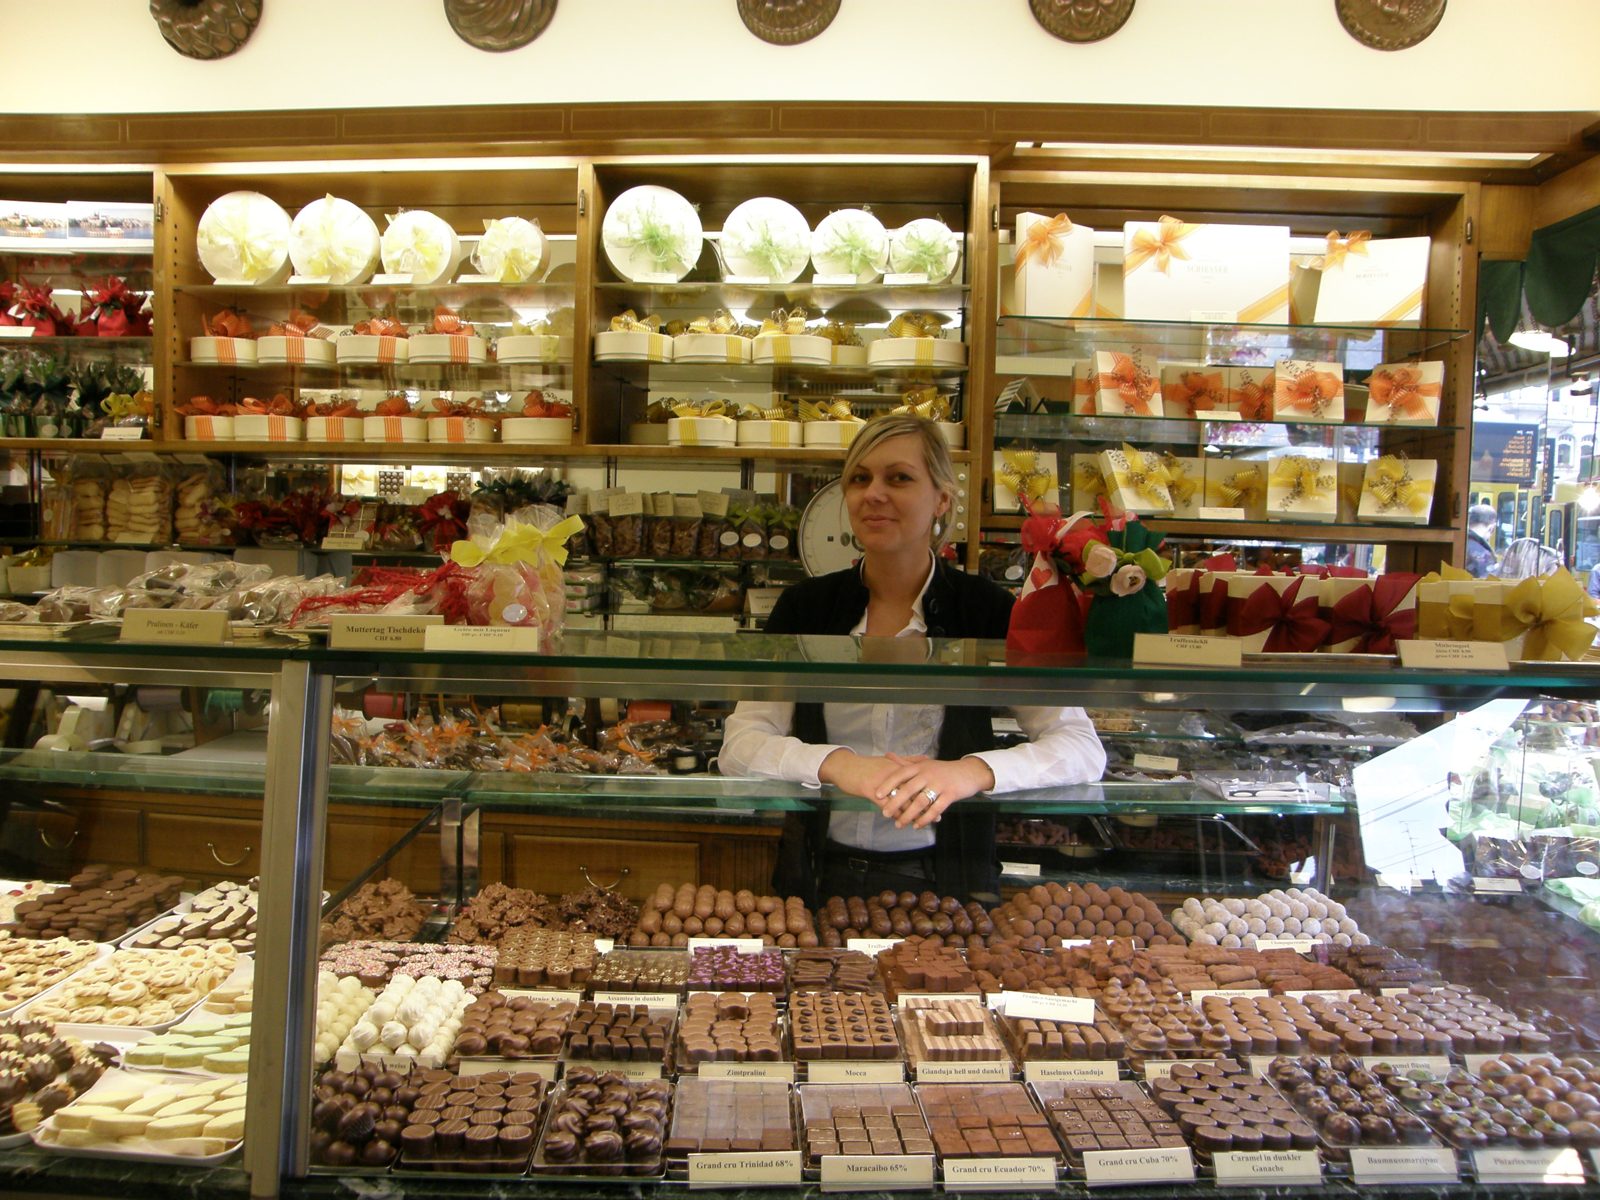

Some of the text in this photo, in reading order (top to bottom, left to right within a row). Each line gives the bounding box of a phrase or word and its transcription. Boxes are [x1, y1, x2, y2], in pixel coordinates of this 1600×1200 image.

[147, 619, 174, 628] Pralinen
[180, 621, 199, 630] Käfer
[346, 626, 385, 634] Muttertag
[726, 1069, 766, 1077] Zimtpraliné
[696, 1160, 722, 1170] Grand
[739, 1160, 774, 1168] Trinidad
[1098, 1158, 1124, 1167] Grand
[1139, 1156, 1159, 1165] Cuba
[846, 1164, 887, 1172] Maracaibo
[994, 1166, 1026, 1174] Ecuador
